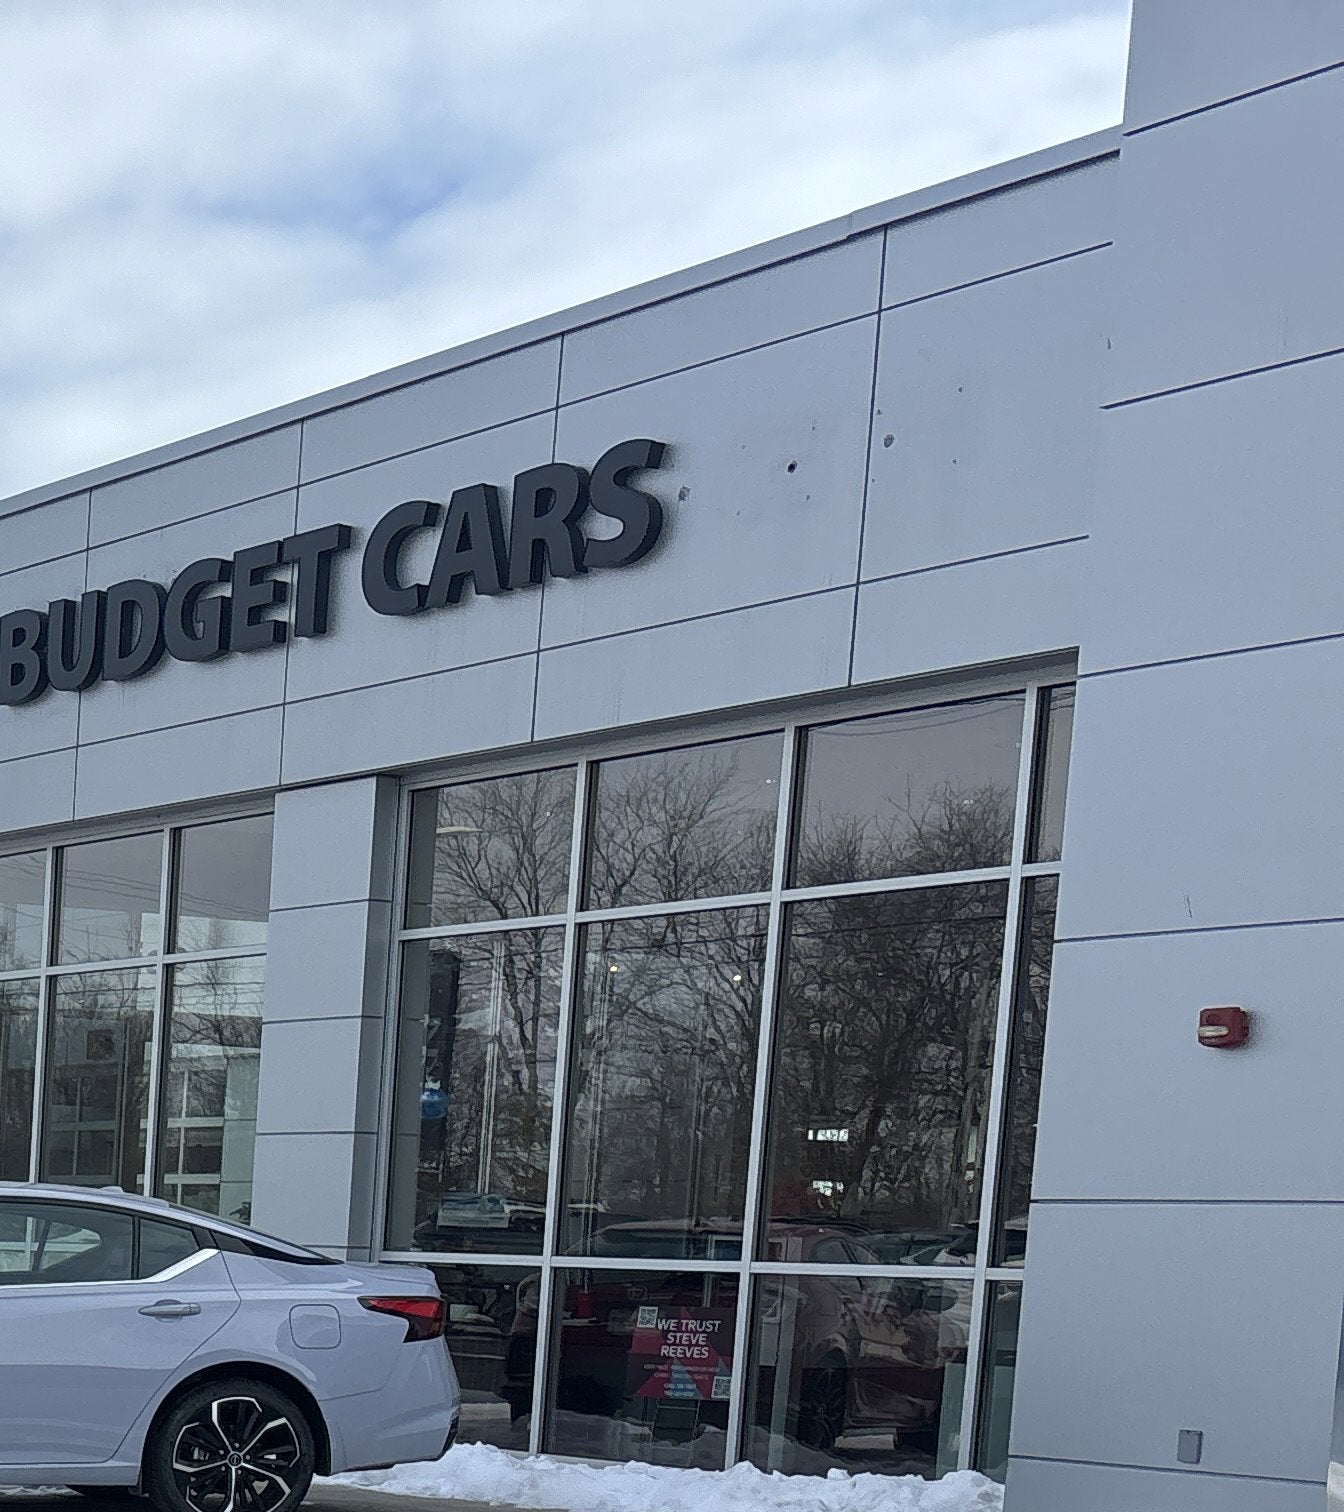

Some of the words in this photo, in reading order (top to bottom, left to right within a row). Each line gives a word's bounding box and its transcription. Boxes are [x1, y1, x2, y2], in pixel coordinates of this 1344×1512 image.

[362, 438, 667, 616] CARS
[657, 1319, 679, 1331] WE
[680, 1320, 721, 1333] TRUST
[666, 1332, 708, 1345] STEVE
[660, 1345, 710, 1359] REEVES
